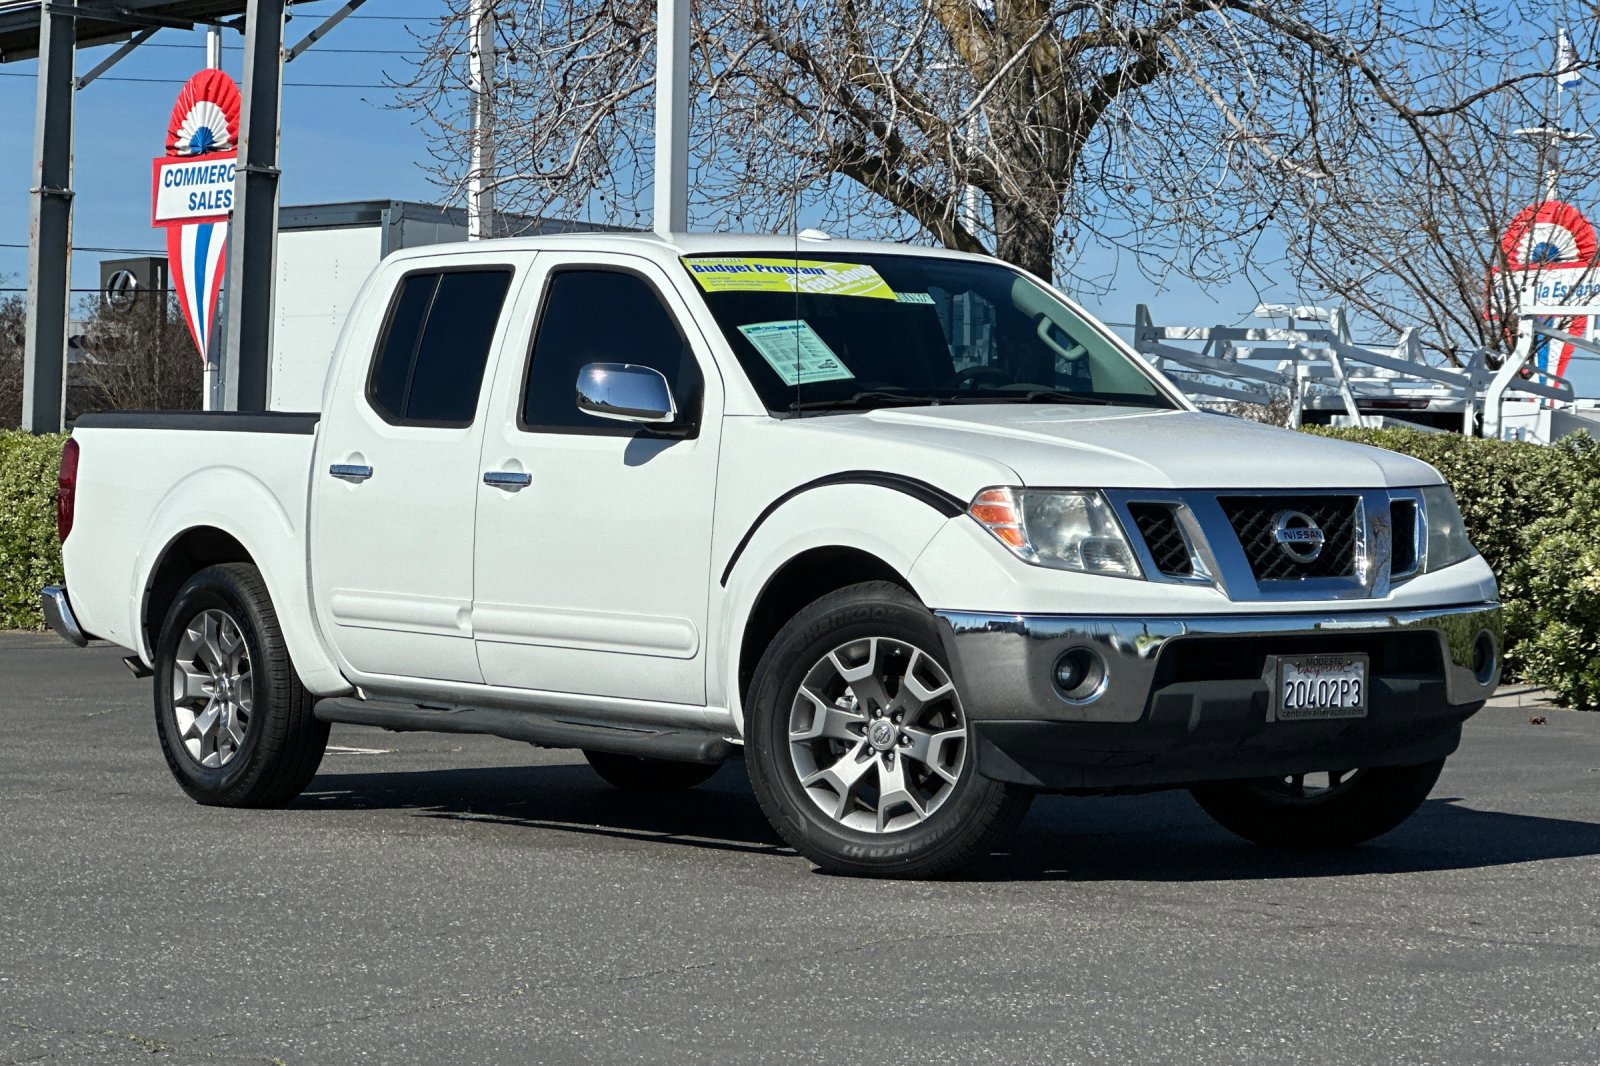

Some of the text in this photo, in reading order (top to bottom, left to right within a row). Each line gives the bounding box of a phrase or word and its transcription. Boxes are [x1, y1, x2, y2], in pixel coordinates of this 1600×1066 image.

[164, 163, 236, 188] COMMERC
[188, 189, 232, 211] SALES
[691, 264, 827, 275] Budget Program
[1283, 530, 1323, 539] NISSAN
[1306, 657, 1344, 666] MODESTO
[1284, 679, 1361, 709] 20402P3
[1282, 707, 1363, 717] centralvalleyauto.com
